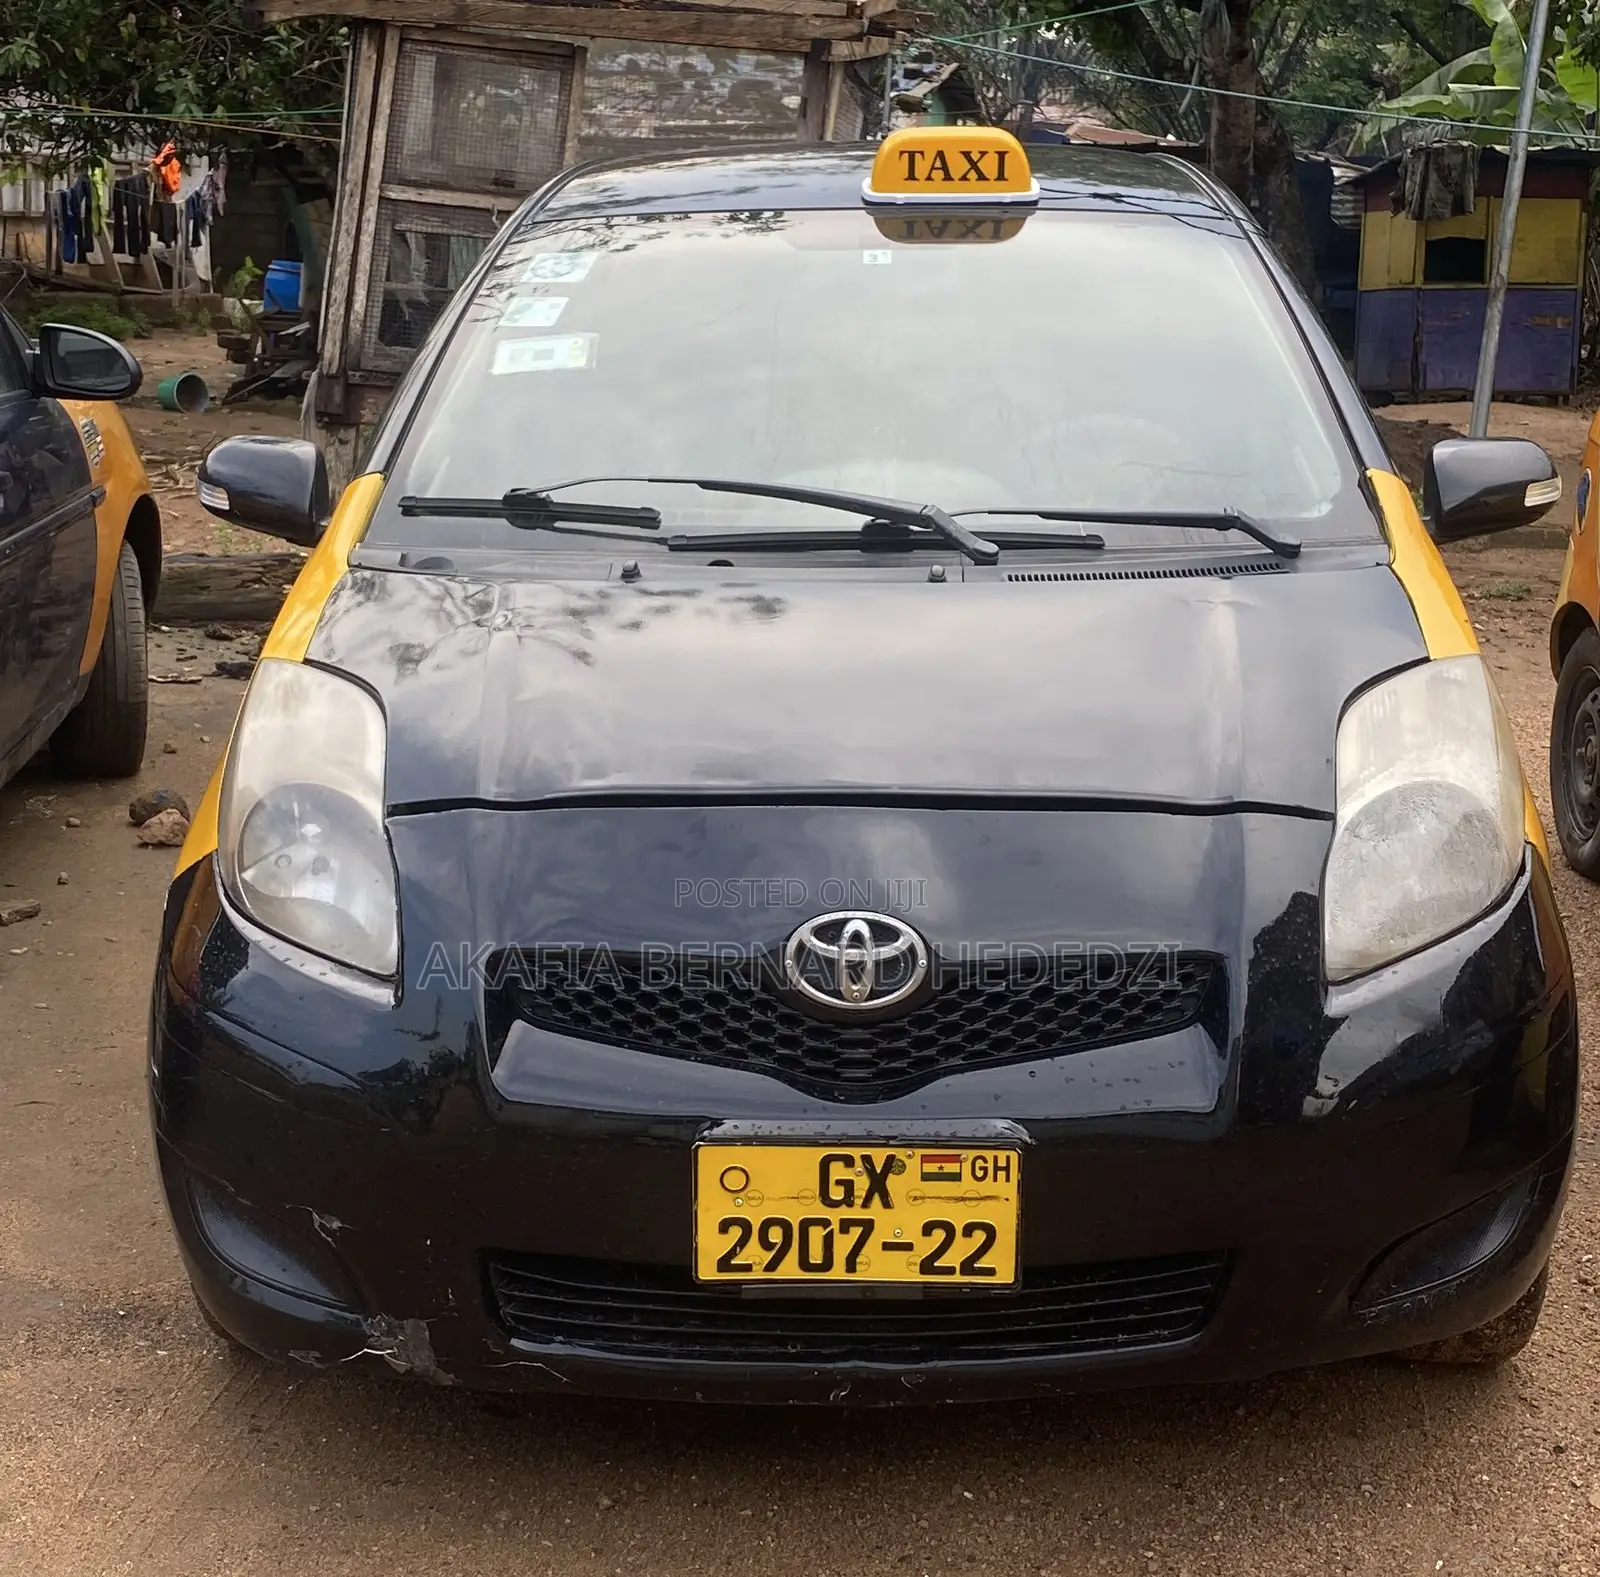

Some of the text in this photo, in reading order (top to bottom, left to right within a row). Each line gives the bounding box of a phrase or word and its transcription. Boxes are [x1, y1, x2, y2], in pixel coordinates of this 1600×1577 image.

[899, 150, 1009, 182] TAXI
[819, 1153, 1011, 1209] GX GH
[717, 1216, 997, 1276] 2907-22
